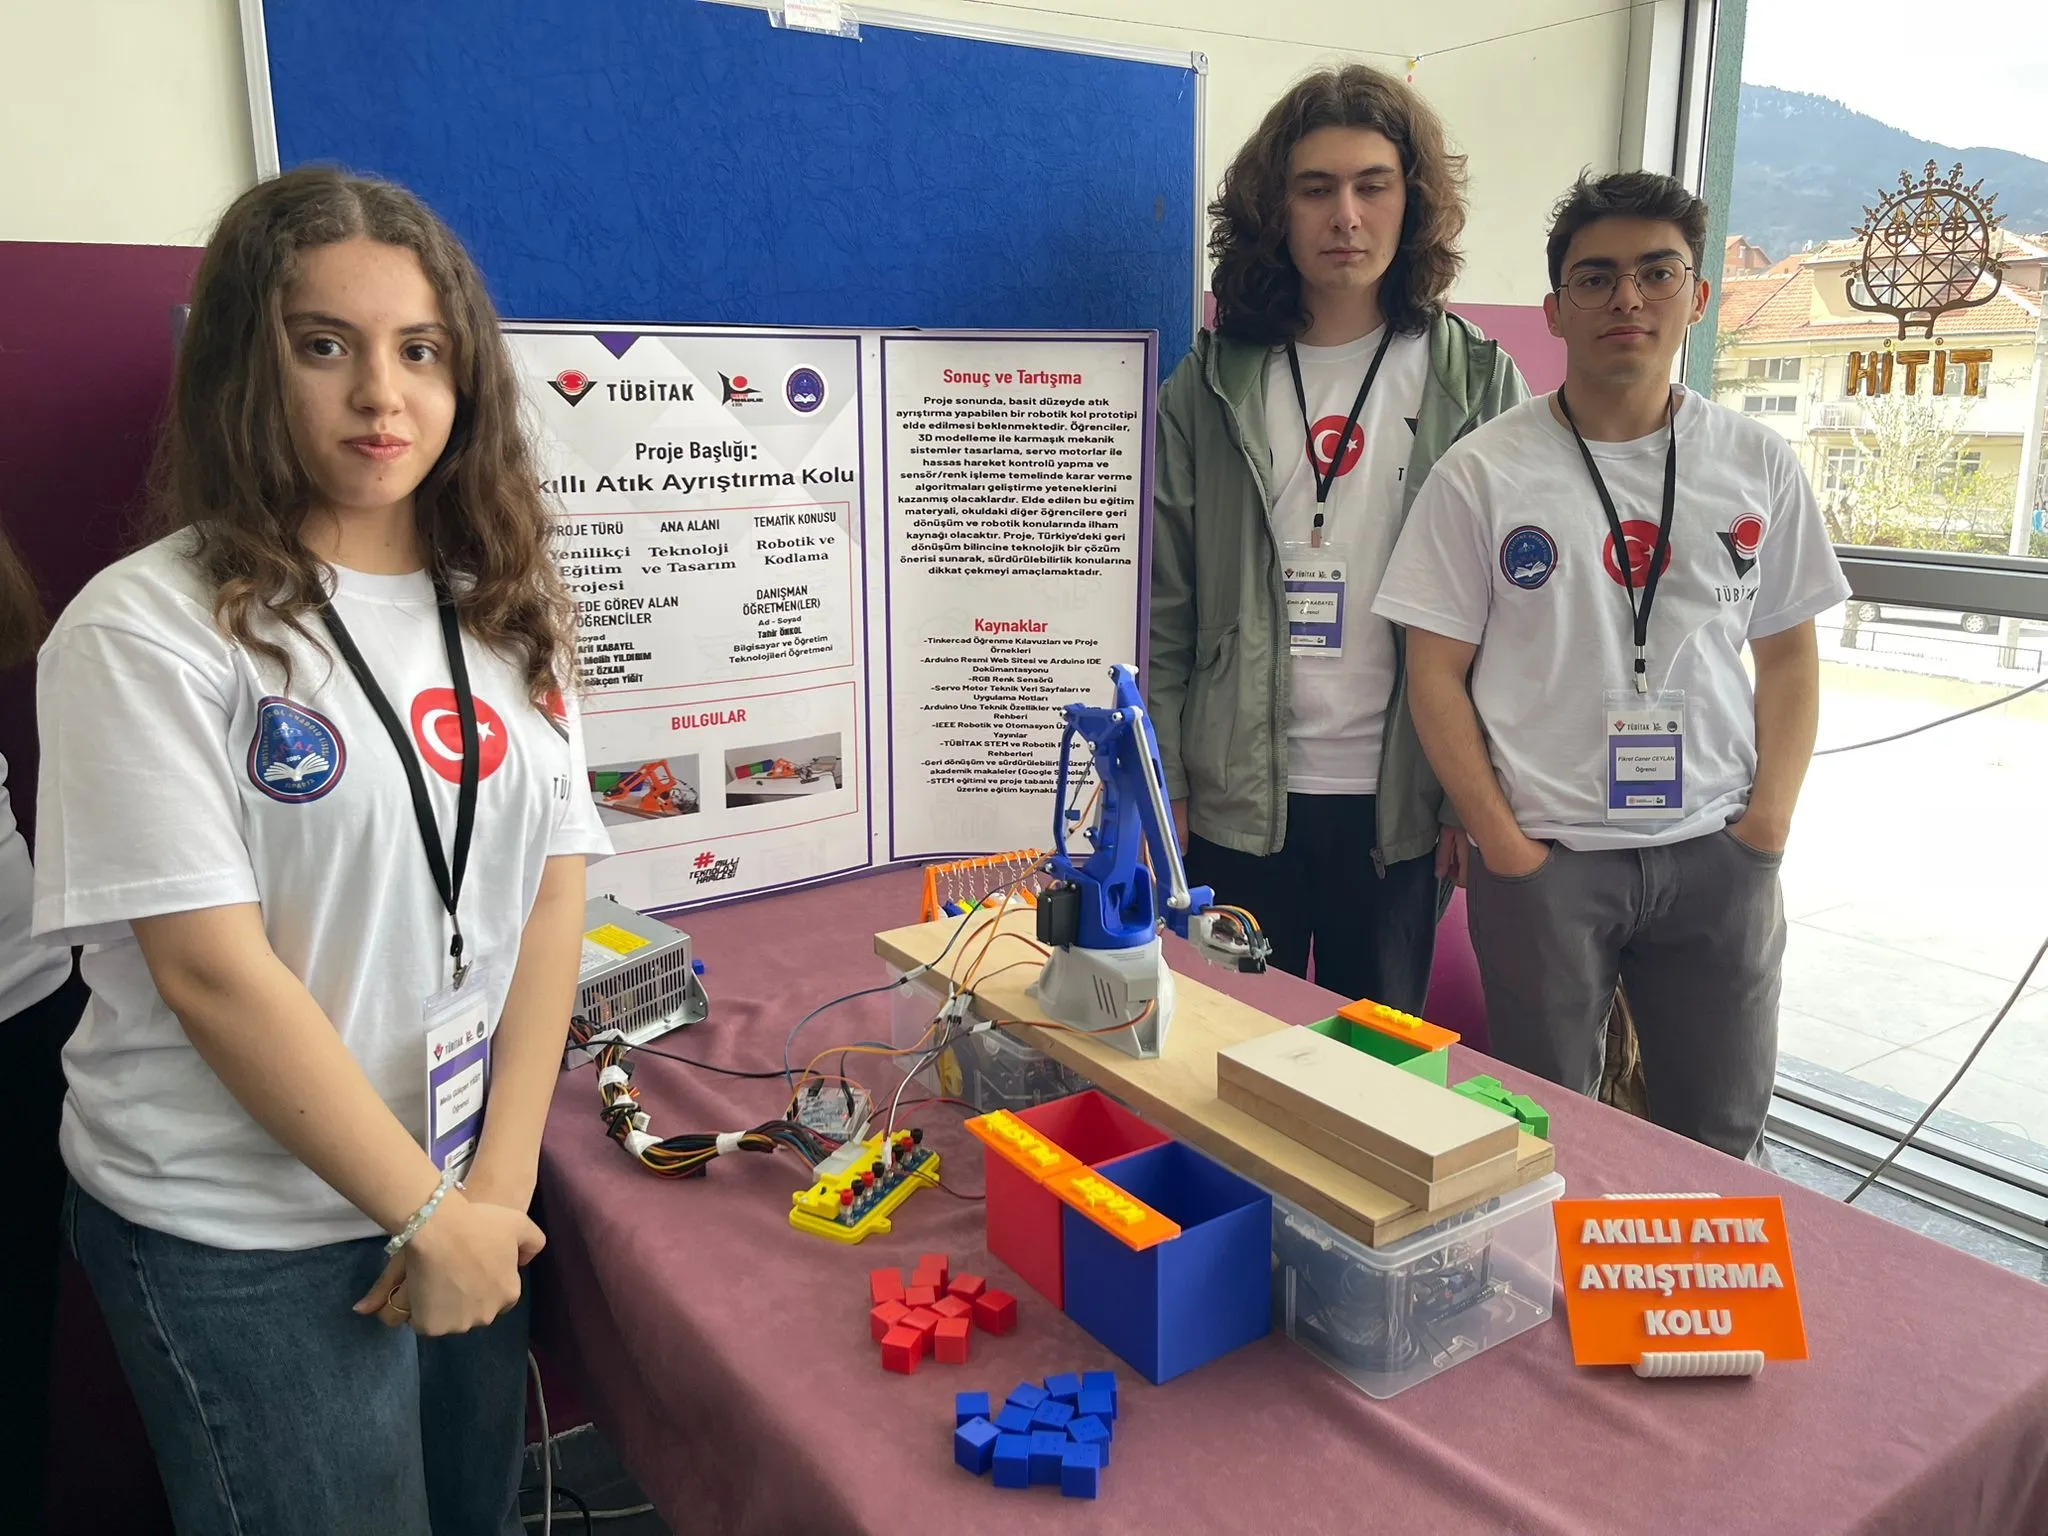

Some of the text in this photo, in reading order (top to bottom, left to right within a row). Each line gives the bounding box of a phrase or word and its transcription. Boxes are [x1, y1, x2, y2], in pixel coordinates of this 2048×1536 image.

[943, 368, 1081, 388] Sonuç ve Tartışma
[606, 379, 694, 401] TÜBİTAK
[923, 396, 1109, 407] Proje sonunda, basit düzeyde atık
[896, 409, 1137, 420] ayrıştırma yapabilen bir robotik kol prototipi
[902, 421, 1130, 432] elde edilmesi beklenmektedir. Öğrenciler,
[918, 433, 1114, 444] 3D modelleme ile karmaşık mekanik
[635, 440, 757, 464] Proje Başlığı:
[910, 446, 962, 454] sistemler
[964, 446, 1022, 455] tasarlama,
[1059, 447, 1107, 455] motorlar
[1109, 447, 1122, 456] ile
[922, 458, 1093, 469] hassas hareket kontrolü yapma
[539, 466, 854, 494] kıllı Atık Ayrıştırma Kolu
[900, 470, 967, 478] sensör/renk
[969, 470, 1006, 480] işleme
[1008, 471, 1063, 479] temelinde
[1065, 472, 1095, 480] karar
[915, 482, 1117, 493] algoritmaları geliştirme yeteneklerini
[898, 494, 1134, 506] kazanmış olacaklardır. Elde edilen bu eğitim
[905, 506, 1127, 518] materyali, okuldaki diğer öğrencilere geri
[753, 511, 836, 527] TEMATİK KONUSU
[913, 518, 1118, 528] dönüşüm robotik konularında ilham
[590, 521, 623, 535] TÜRÜ
[659, 519, 719, 532] ANA ALANI
[906, 530, 1125, 542] kaynağı olacaktır. Proje, Türkiye'deki geri
[756, 536, 835, 550] Robotik ve
[910, 542, 1120, 553] dönüşüm bilincine teknolojik bir çözüm
[551, 546, 631, 560] Yenilikçi
[647, 543, 728, 557] Teknoloji
[764, 552, 829, 565] Kodlama
[899, 554, 1131, 565] önerisi sunarak, sürdürülebilirlik konularına
[558, 564, 622, 579] Eğitim
[641, 561, 736, 574] ve Tasarım
[927, 566, 1102, 576] dikkat çekmeyi amaçlamaktadır.
[756, 584, 808, 601] DANIŞMAN
[604, 597, 644, 611] GÖREV
[647, 595, 678, 608] ALAN
[742, 597, 820, 615] ÖĞRETMEN(LER)
[777, 615, 802, 625] Soyad
[974, 618, 1048, 635] Kaynaklar
[733, 642, 780, 652] Bilgisayar
[793, 635, 828, 646] Öğretim
[973, 637, 1013, 645] Öğrenme
[1074, 638, 1098, 646] Proje
[728, 644, 833, 663] Teknolojileri Öğretmeni
[990, 645, 1031, 653] Örnekleri
[972, 665, 1049, 674] Dokümantasyonu
[989, 684, 1018, 692] Teknik
[1039, 686, 1078, 694] Sayfaları
[973, 694, 1016, 702] Uygulama
[1009, 703, 1049, 711] Özellikler
[671, 708, 746, 730] BULGULAR
[993, 712, 1027, 720] Rehberi
[1005, 722, 1054, 730] Otomasyon
[992, 731, 1027, 739] Yayınlar
[943, 758, 984, 766] dönüşüm
[1017, 768, 1052, 776] (Google
[956, 777, 986, 785] eğitimi
[990, 786, 1018, 794] eğitim
[1580, 1217, 1769, 1244] AKILLI ATIK
[1643, 1309, 1733, 1336] KOLU
